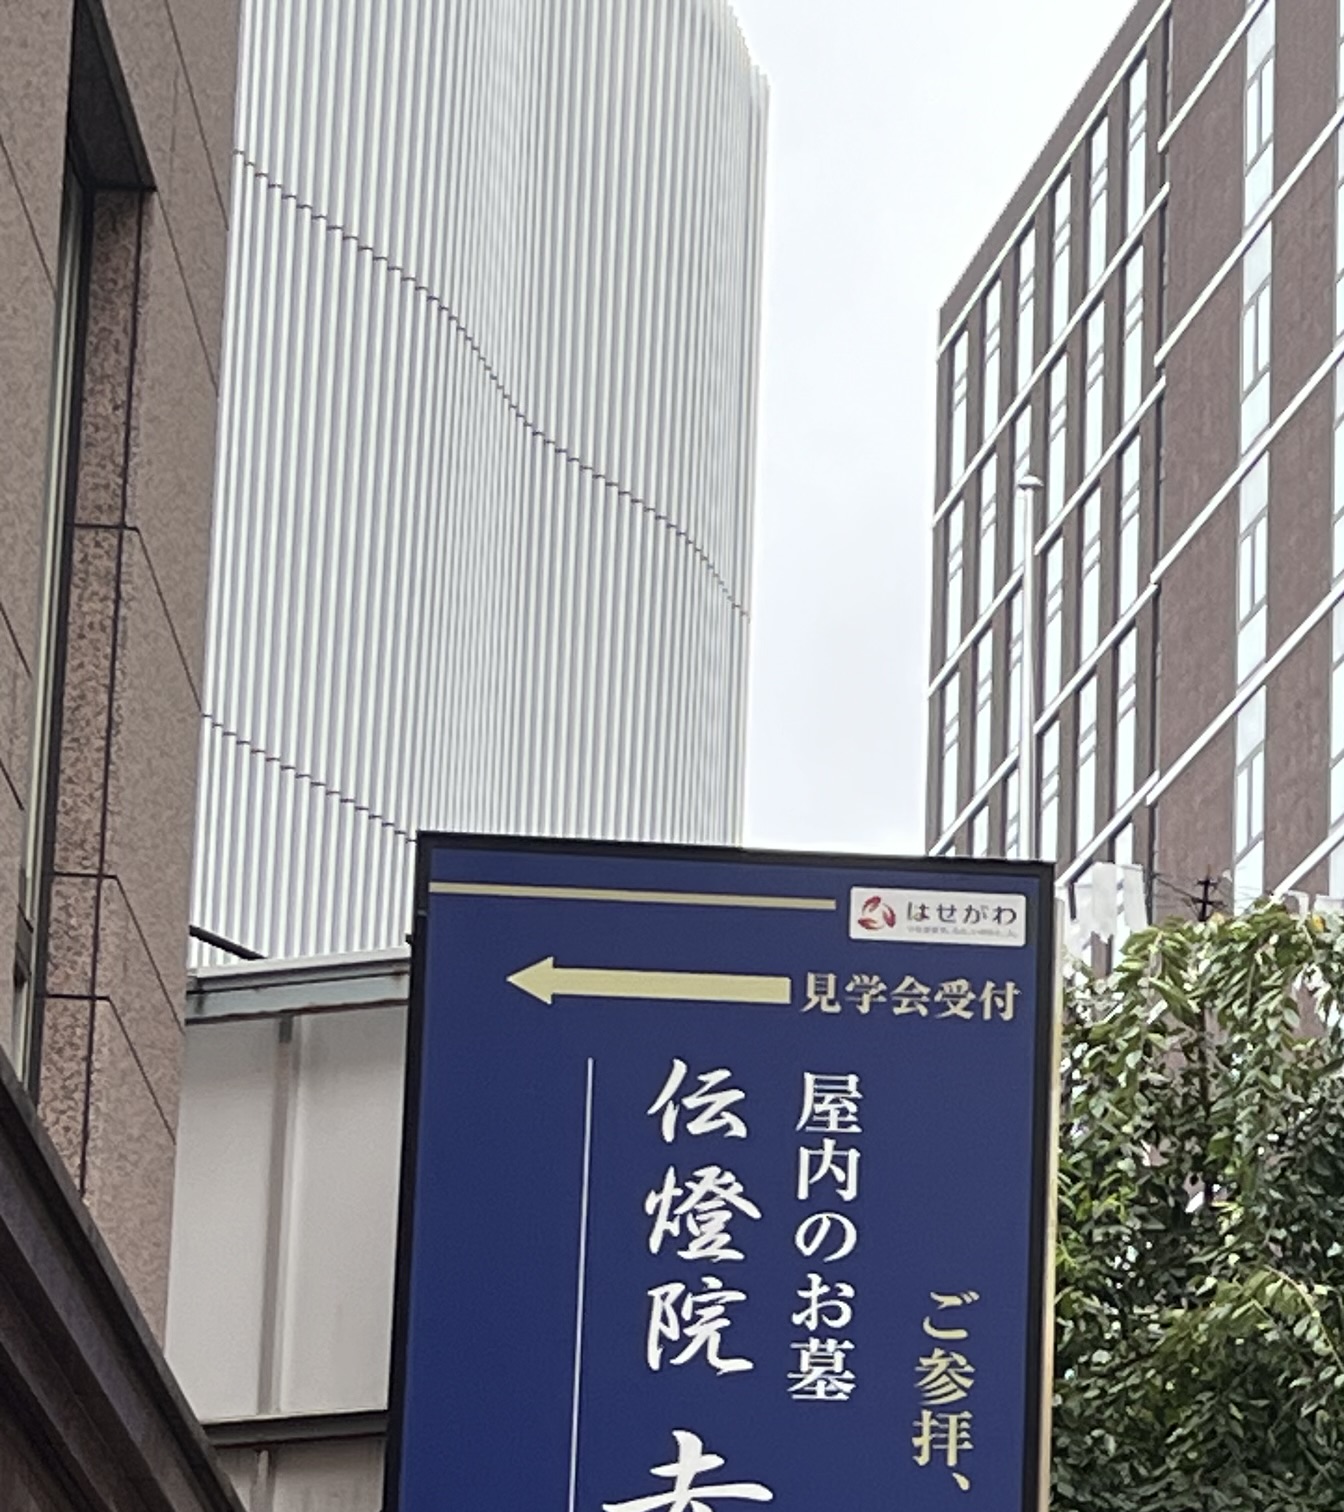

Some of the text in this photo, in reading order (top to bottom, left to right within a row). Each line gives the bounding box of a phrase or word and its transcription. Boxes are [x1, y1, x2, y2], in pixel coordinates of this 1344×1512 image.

[800, 972, 1021, 1022] 見学会受付
[907, 901, 1018, 925] はせがわ
[645, 1057, 762, 1375] 伝燈院
[787, 1072, 863, 1402] 屋内のお墓
